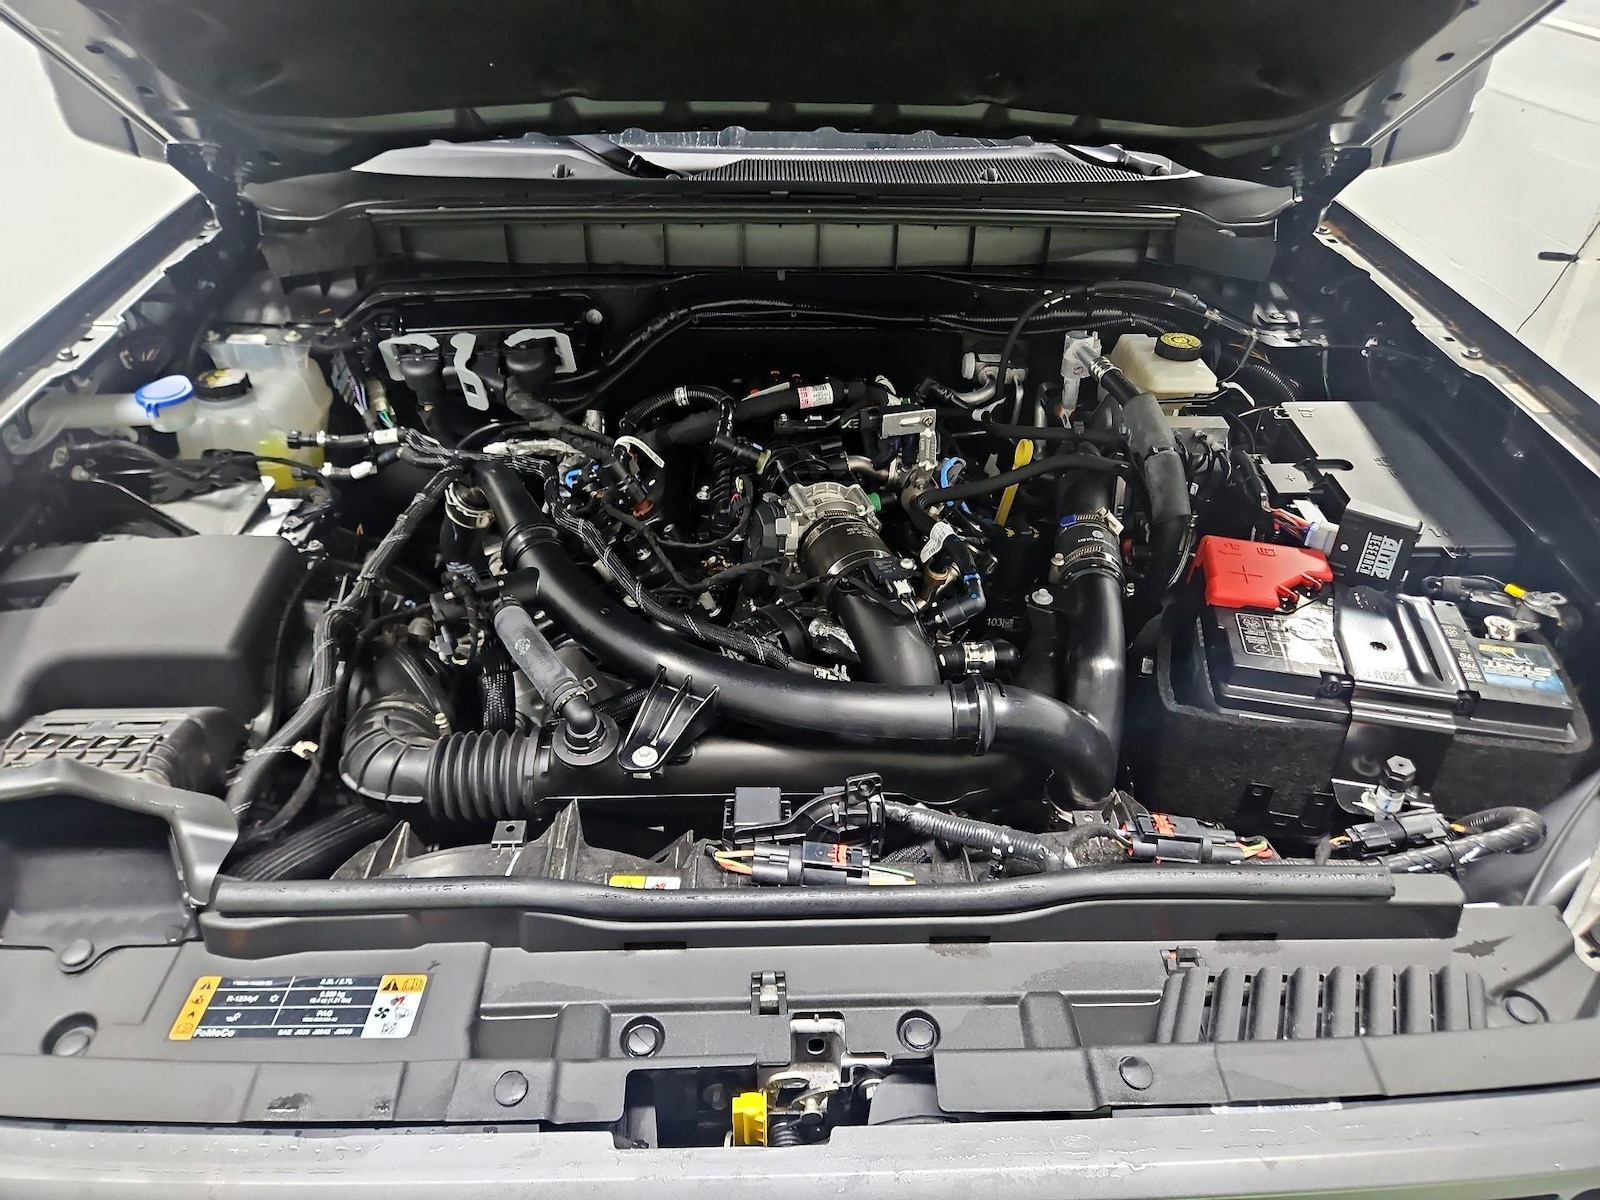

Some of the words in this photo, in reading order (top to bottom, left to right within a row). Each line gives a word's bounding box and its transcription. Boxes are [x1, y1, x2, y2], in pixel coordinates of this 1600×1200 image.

[1360, 534, 1383, 575] RESEARCH
[1482, 659, 1552, 676] START
[226, 995, 260, 1004] R-1234yf
[193, 1028, 236, 1038] FoMoCo
